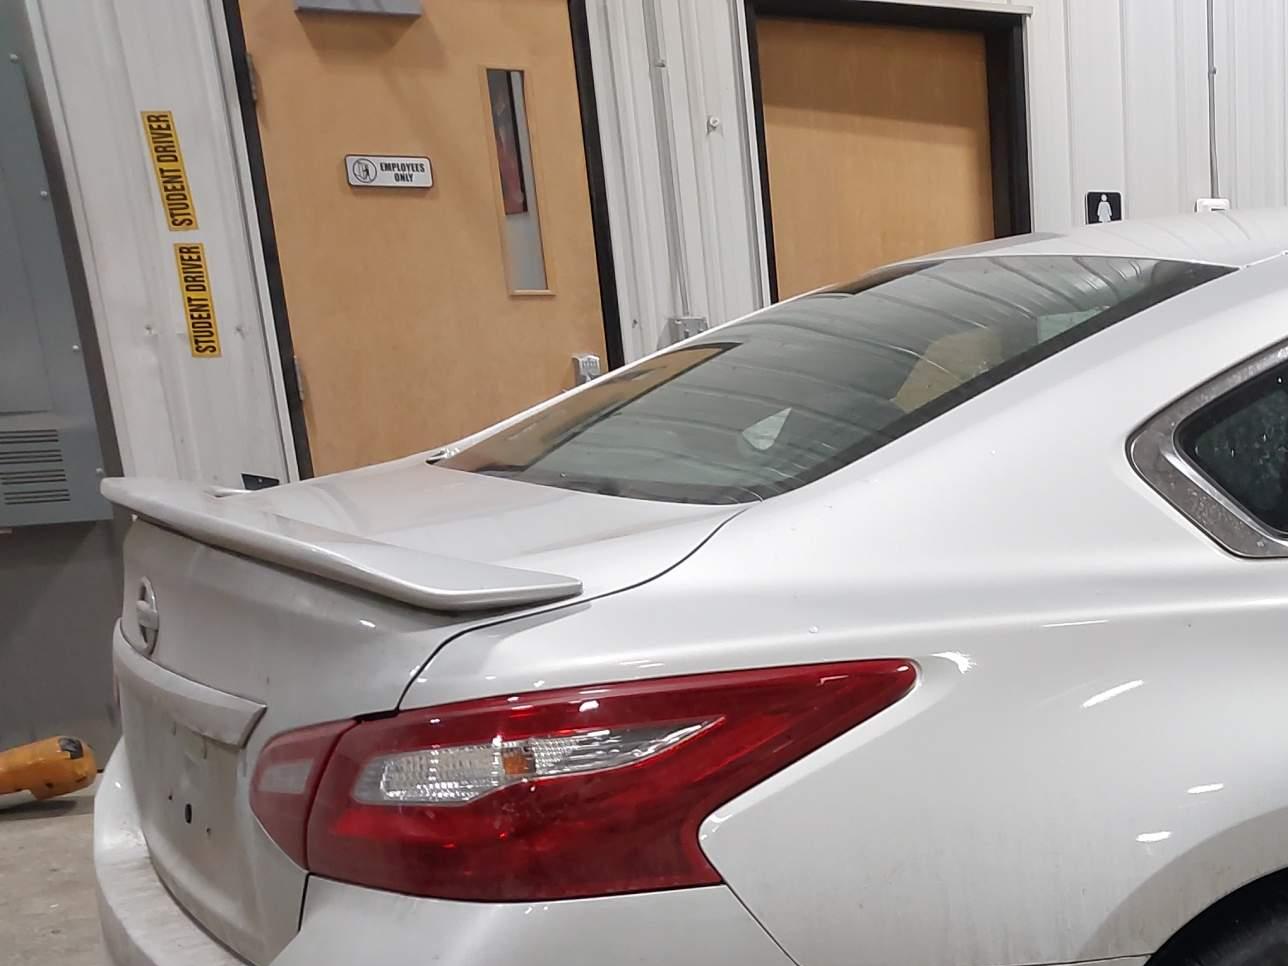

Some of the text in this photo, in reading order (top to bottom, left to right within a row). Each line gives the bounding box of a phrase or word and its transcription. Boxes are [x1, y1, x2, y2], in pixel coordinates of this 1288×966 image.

[147, 114, 193, 226] STUDENT DRIVER
[380, 162, 425, 172] EMPLOYEES
[394, 173, 413, 182] ONLY
[178, 246, 217, 353] STUDENT DRIVER
